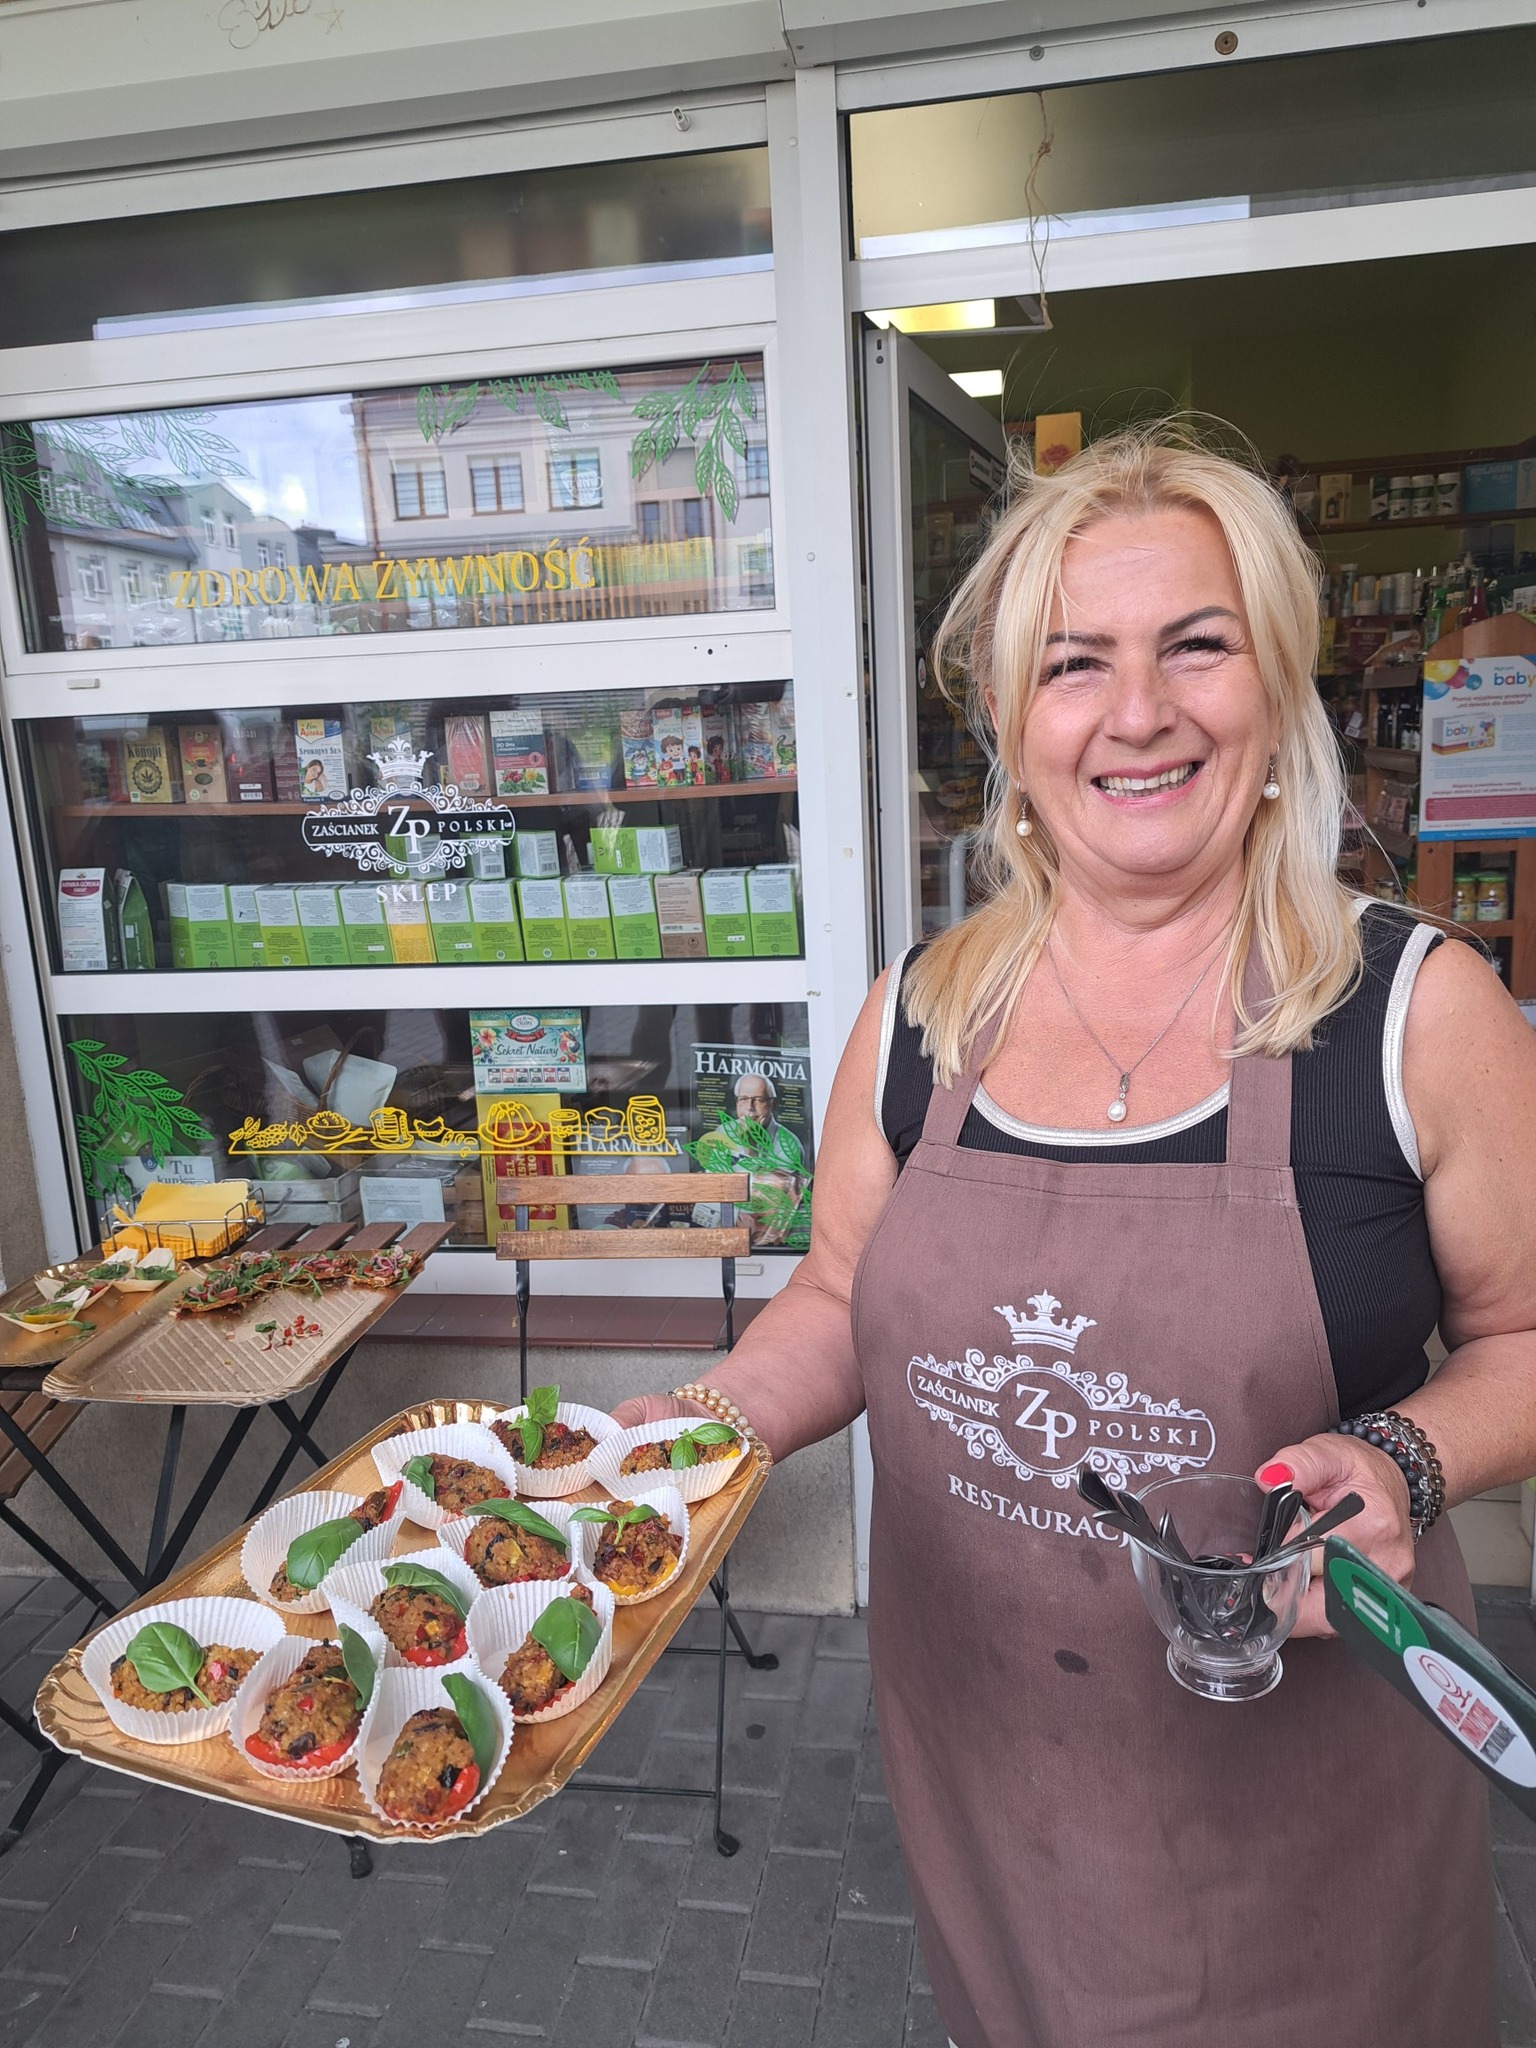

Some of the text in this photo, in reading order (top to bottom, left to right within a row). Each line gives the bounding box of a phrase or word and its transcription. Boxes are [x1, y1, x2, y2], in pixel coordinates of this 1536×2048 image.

[169, 536, 597, 609] ZDROWA ŻYWNOŚĆ
[1494, 672, 1536, 688] baby
[1445, 725, 1475, 737] baby
[311, 822, 380, 838] ZAŚCIANEK
[387, 805, 431, 854] ZP
[437, 819, 505, 833] POLSKI
[375, 883, 457, 904] SKLEP
[495, 1043, 560, 1058] Sekret Natury
[694, 1051, 807, 1081] HARMONIA
[170, 1160, 194, 1175] Tu
[917, 1375, 1000, 1418] ZAŚCIANEK
[1015, 1383, 1078, 1460] ZP
[1087, 1419, 1199, 1447] POLSKI
[948, 1474, 1129, 1548] RESTAURACJ
